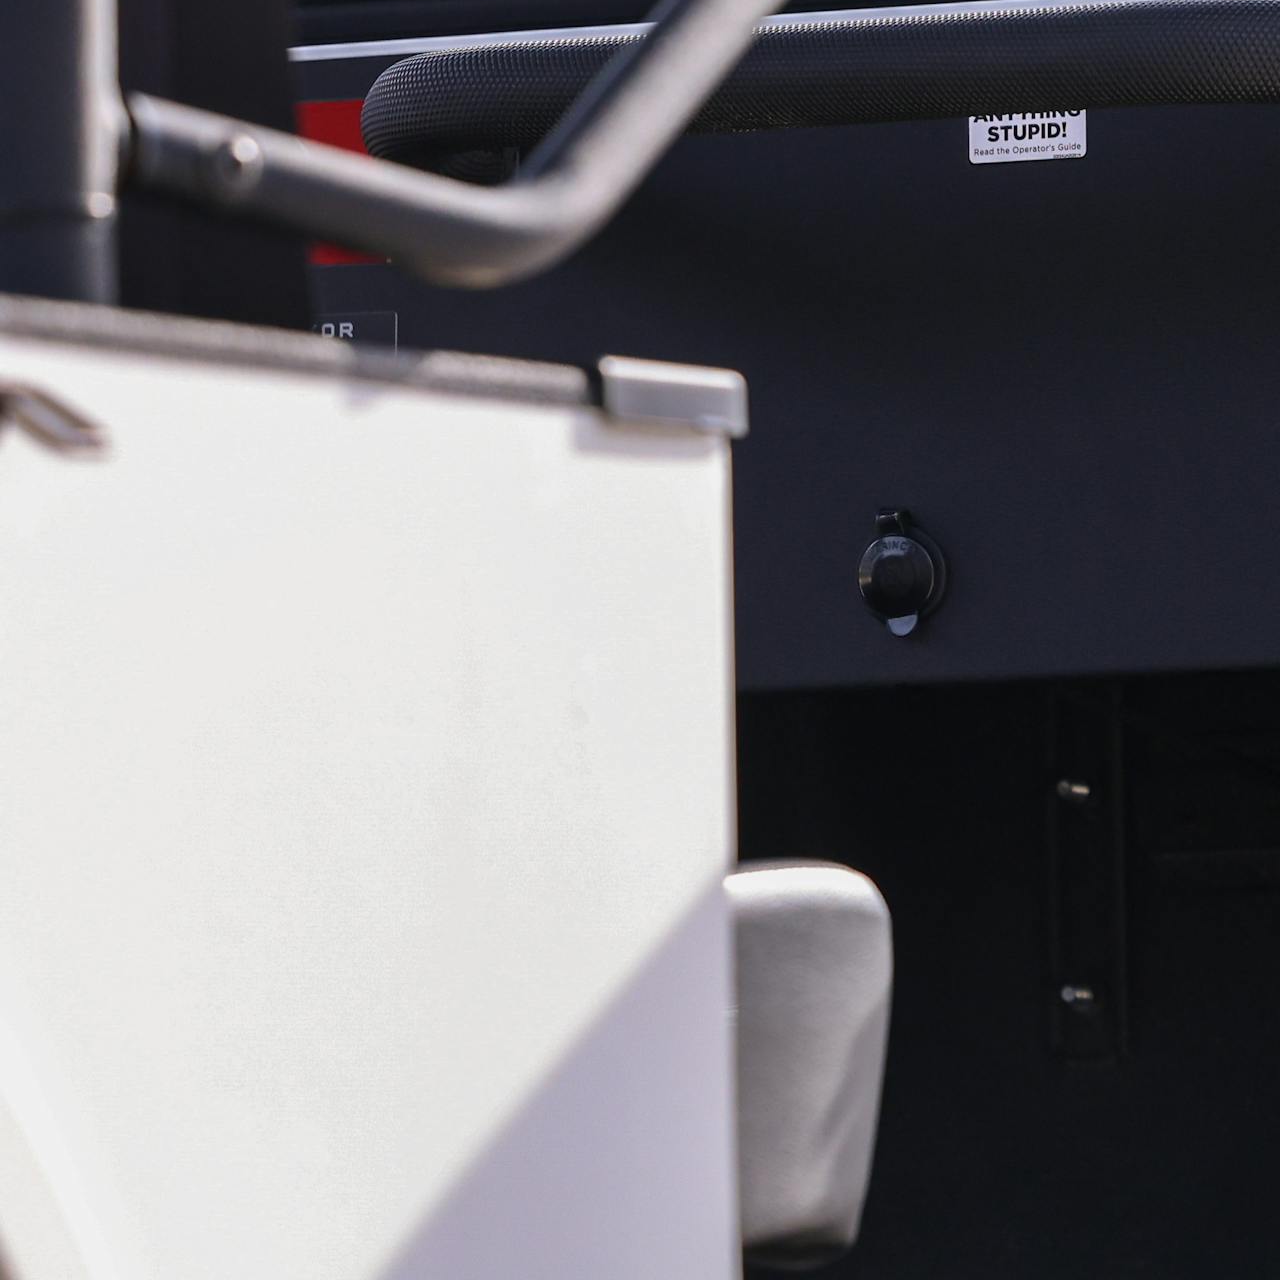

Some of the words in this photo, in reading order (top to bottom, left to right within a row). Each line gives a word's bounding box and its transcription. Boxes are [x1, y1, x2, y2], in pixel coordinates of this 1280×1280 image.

[987, 122, 1067, 142] STUPID!
[974, 148, 994, 156] Read
[997, 147, 1010, 155] the
[1012, 145, 1055, 154] Operator's
[1057, 143, 1081, 151] Guide
